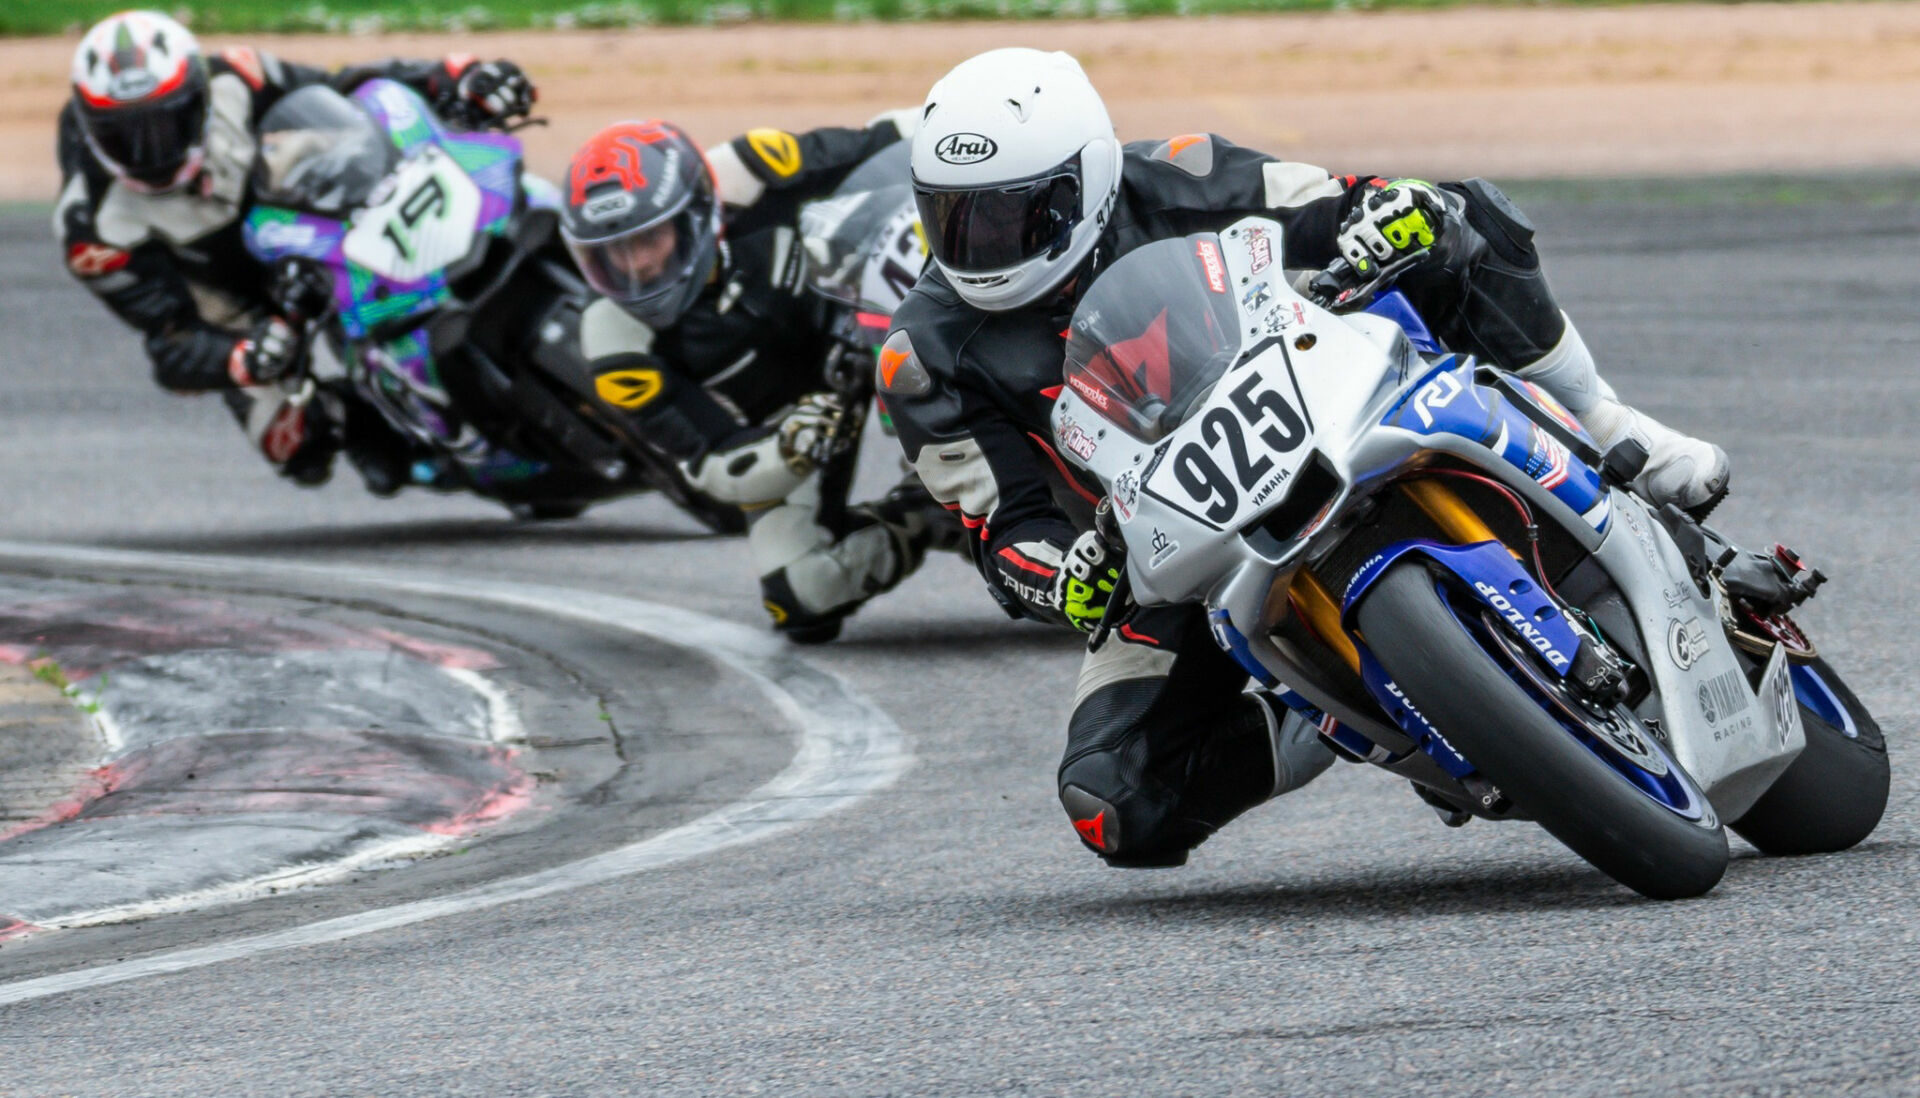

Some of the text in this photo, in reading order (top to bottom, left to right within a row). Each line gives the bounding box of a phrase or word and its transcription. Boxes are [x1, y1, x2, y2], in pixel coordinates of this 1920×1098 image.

[939, 136, 990, 156] Arai
[383, 175, 447, 261] 19
[1173, 370, 1307, 524] 925
[1252, 468, 1291, 507] YAMAHA
[1475, 581, 1569, 668] DUNLOP
[1713, 716, 1752, 742] RACING
